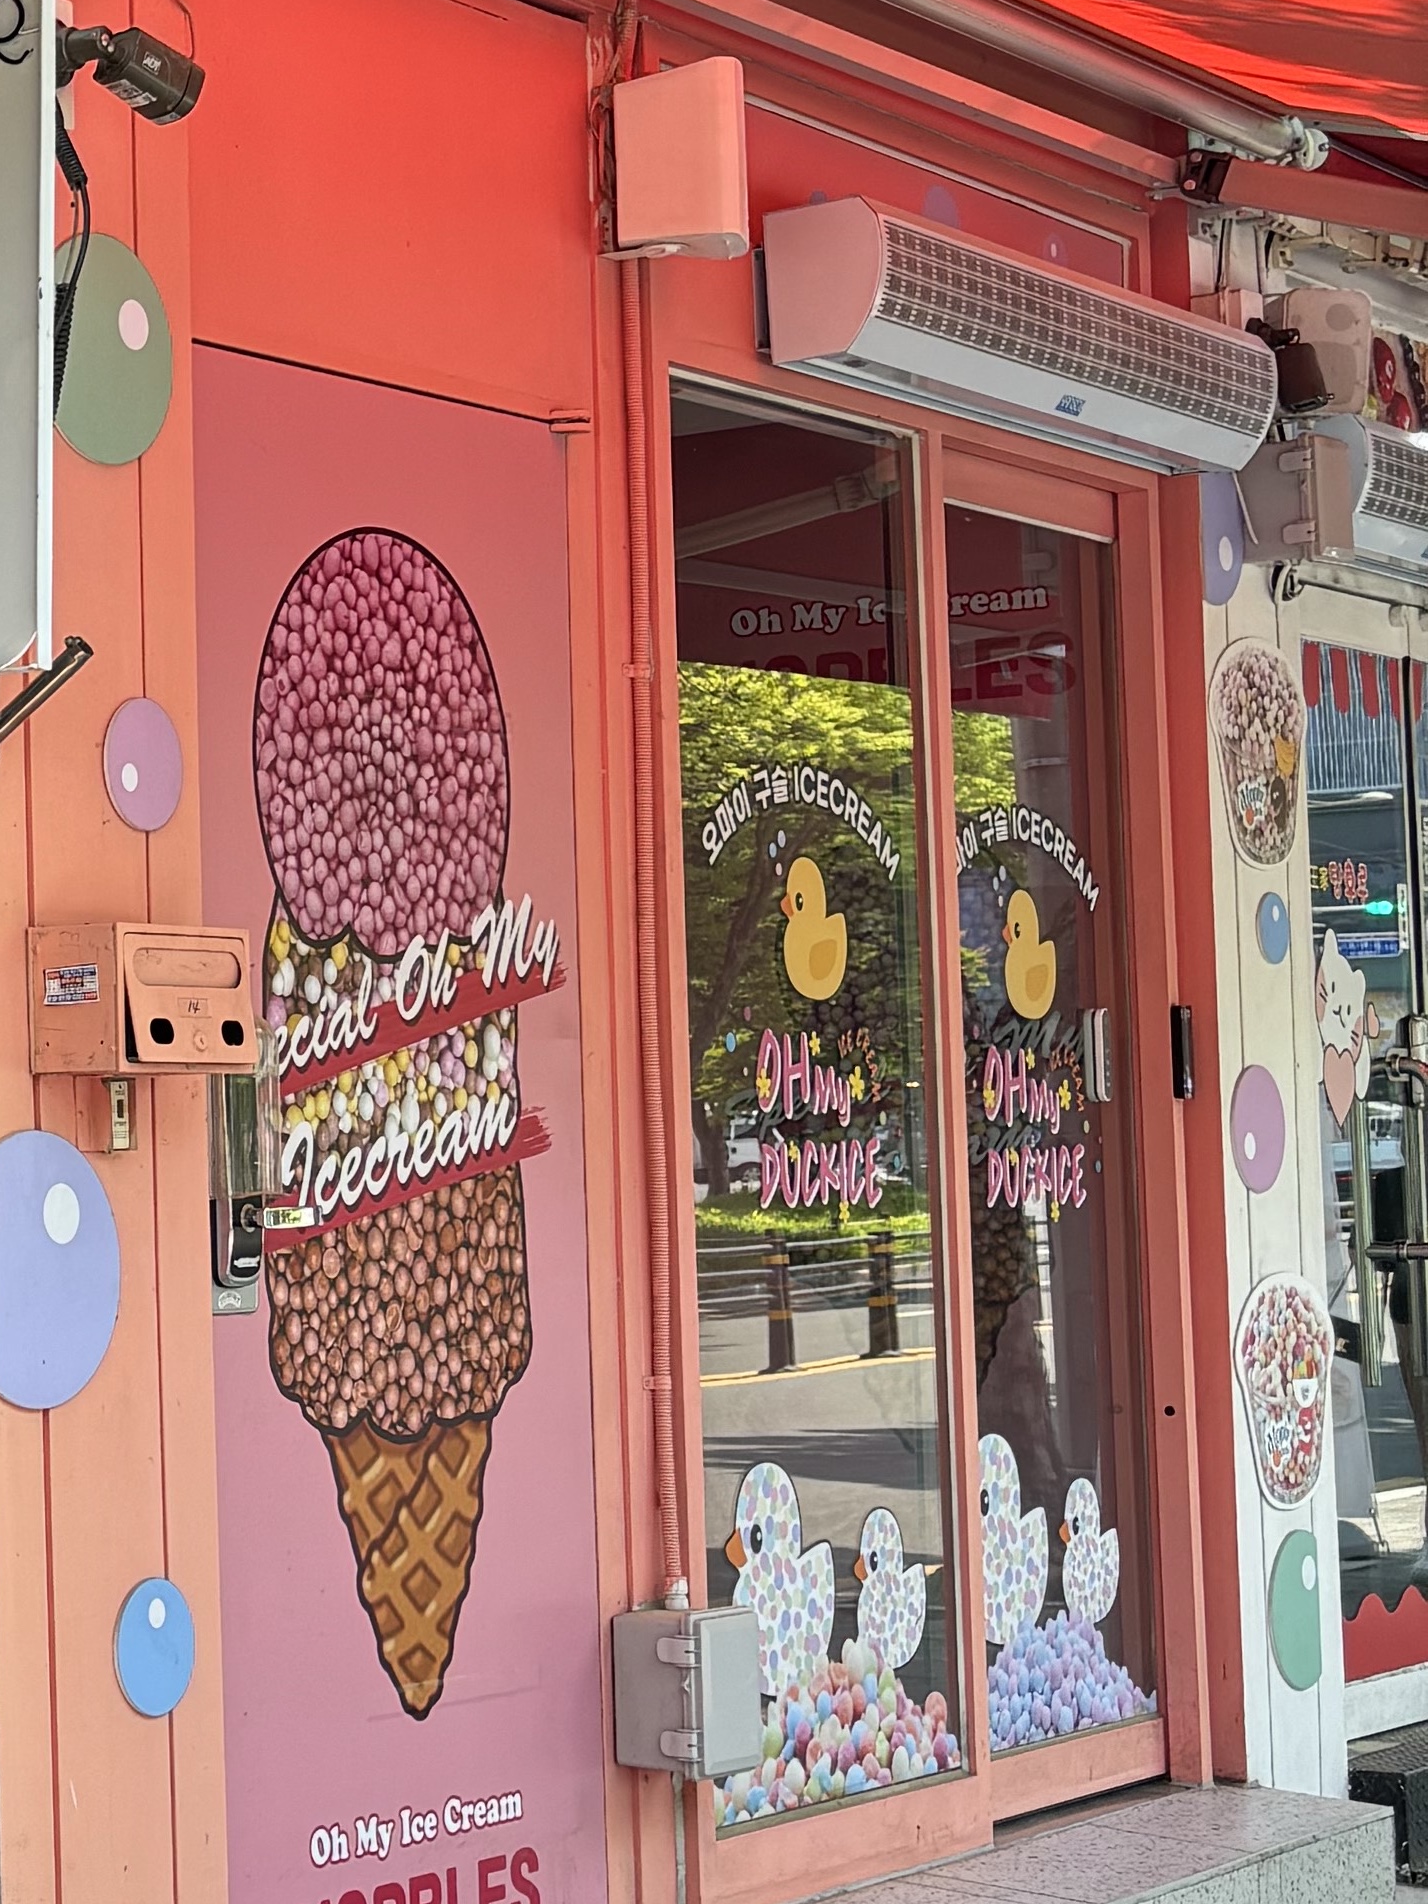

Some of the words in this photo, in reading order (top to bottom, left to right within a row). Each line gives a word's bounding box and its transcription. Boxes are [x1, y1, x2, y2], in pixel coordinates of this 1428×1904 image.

[730, 607, 783, 637] Oh
[792, 601, 847, 634] My
[948, 585, 1049, 617] ream
[702, 782, 752, 866] 오마이
[753, 765, 789, 810] 구슬
[793, 766, 901, 882] ICECREAM
[979, 807, 1009, 847] 구슬
[1012, 807, 1100, 912] ICECREAM
[396, 928, 458, 1021] Oh
[472, 893, 559, 988] My
[756, 1028, 811, 1120] OH
[983, 1044, 1028, 1127] OH
[282, 1093, 517, 1216] Icecream
[310, 1827, 350, 1865] Oh
[354, 1816, 393, 1858] My
[400, 1806, 437, 1846] Ice
[443, 1790, 523, 1833] Cream
